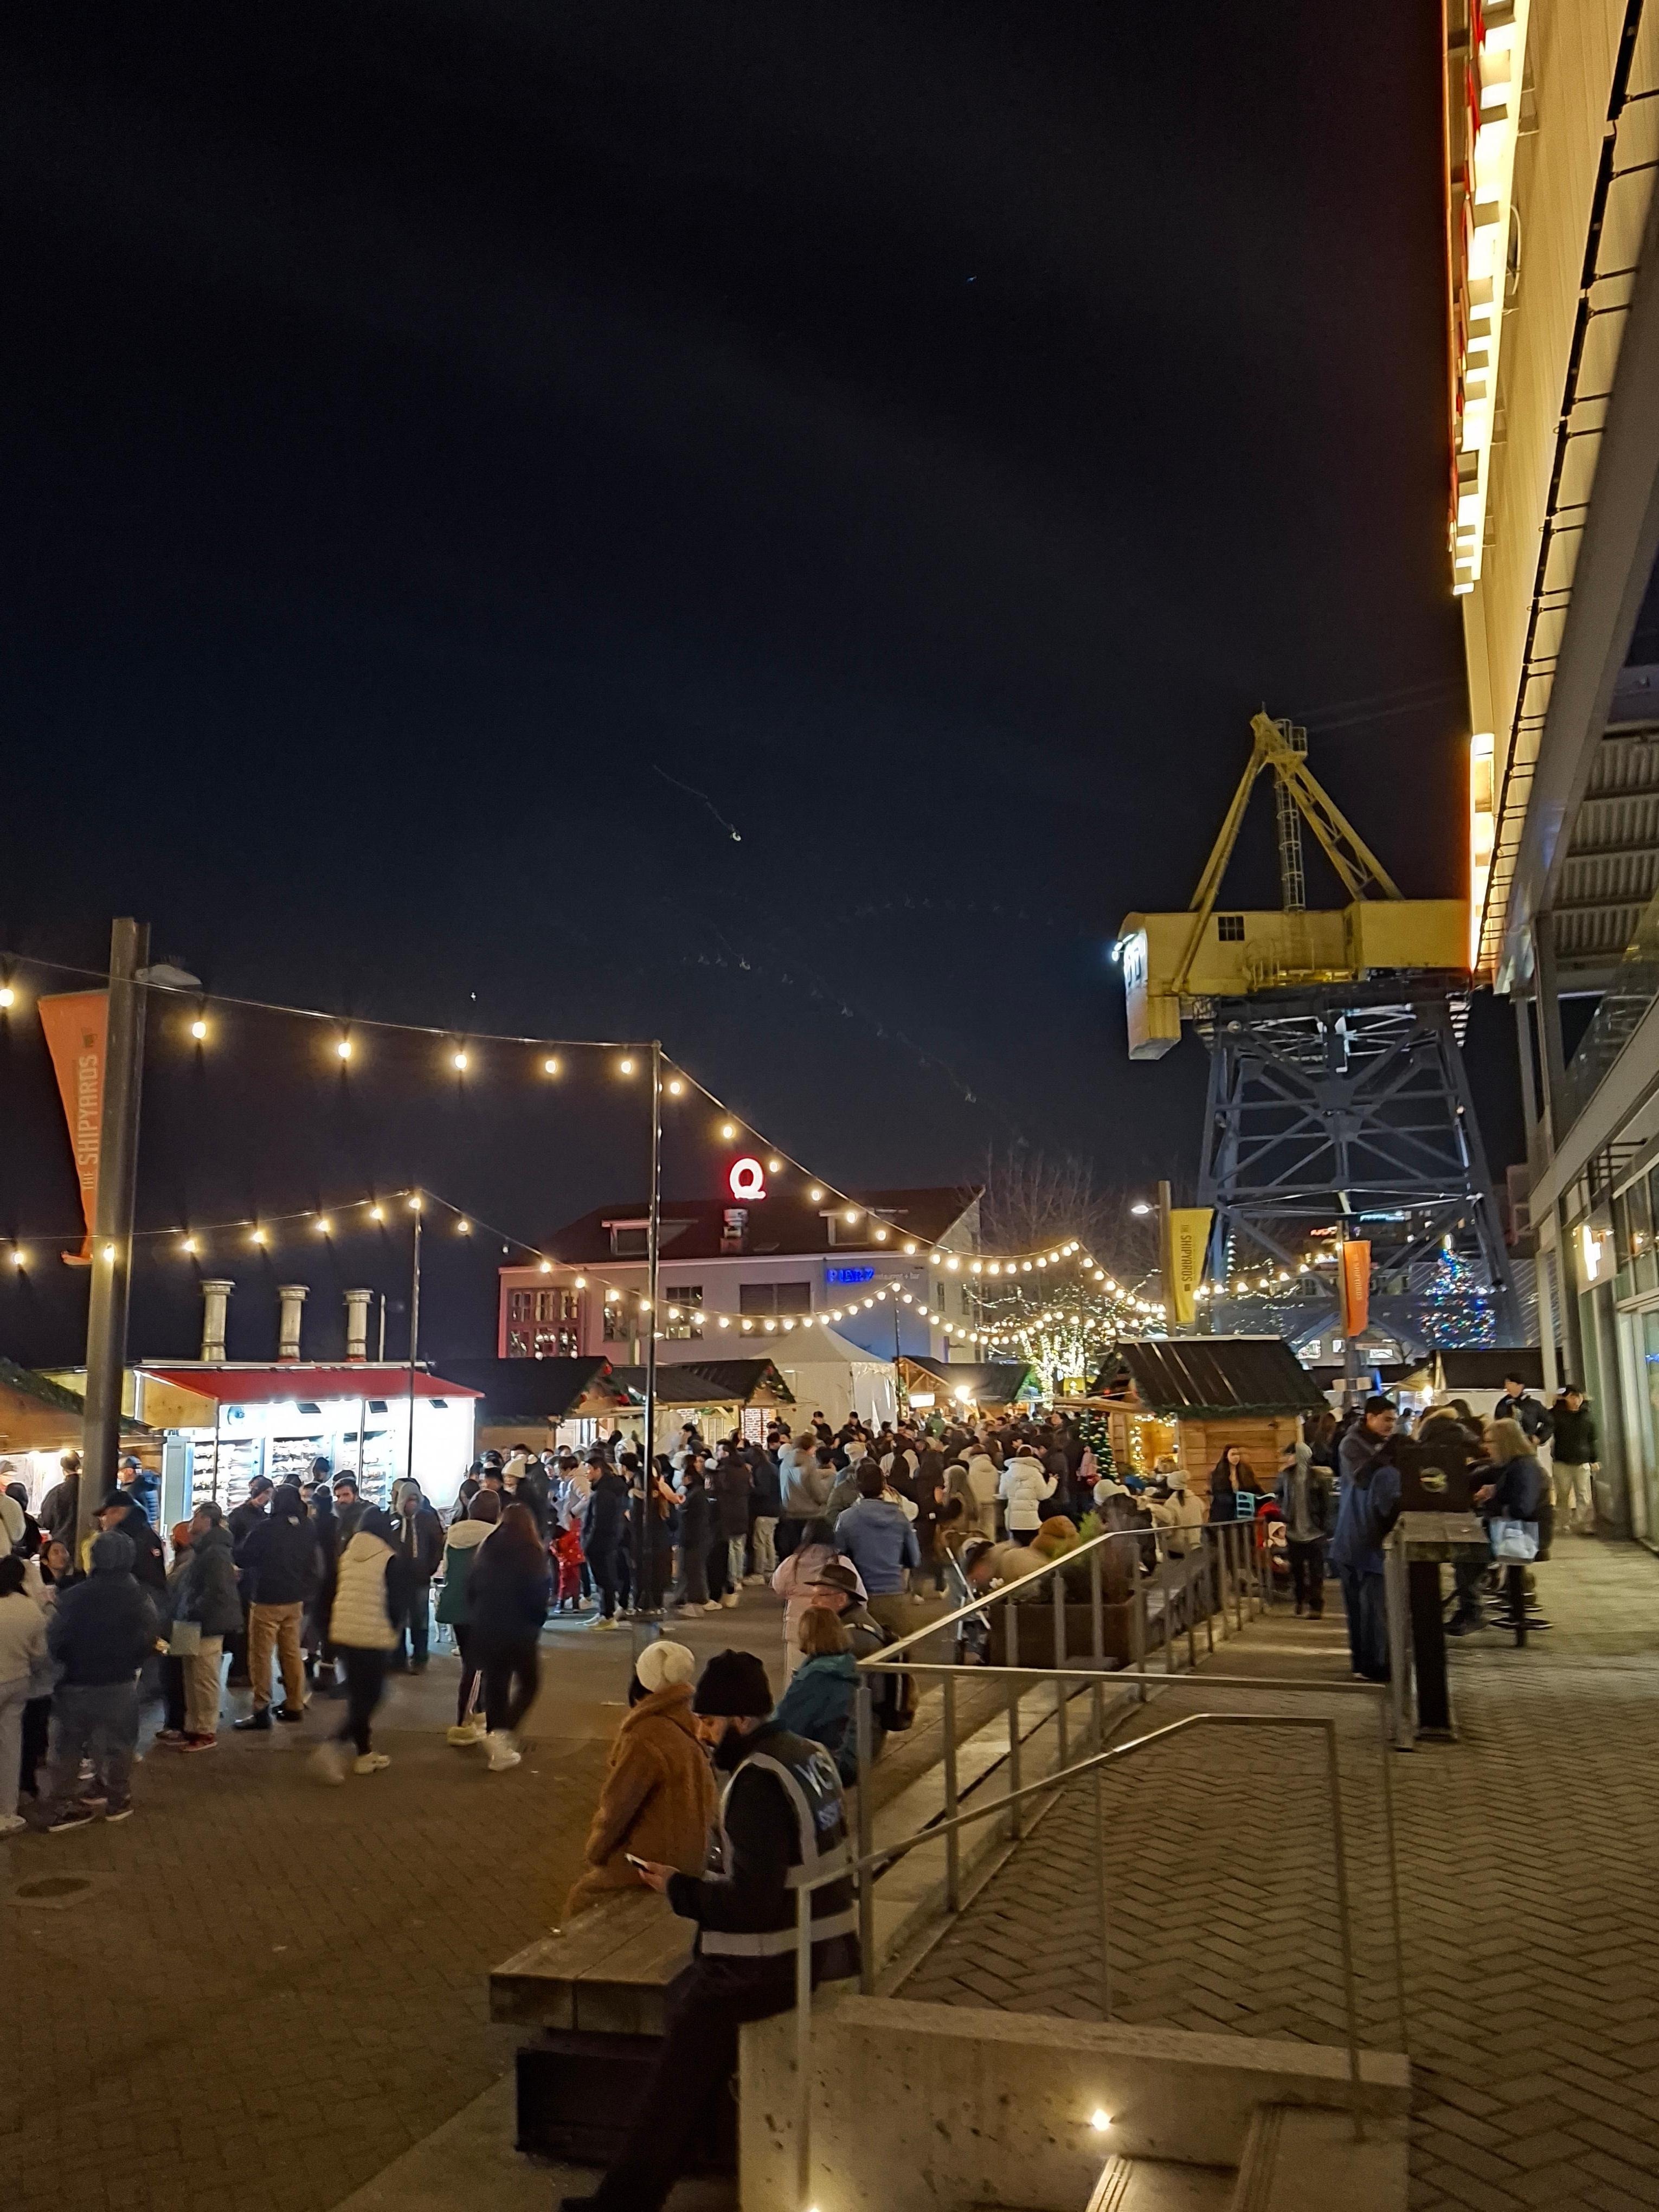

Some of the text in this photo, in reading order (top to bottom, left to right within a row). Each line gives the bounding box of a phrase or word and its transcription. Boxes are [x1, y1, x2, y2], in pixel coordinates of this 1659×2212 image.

[78, 1054, 99, 1166] SHIPYARDS
[729, 1158, 766, 1199] Q
[1180, 1234, 1193, 1282] SHIPYARDS
